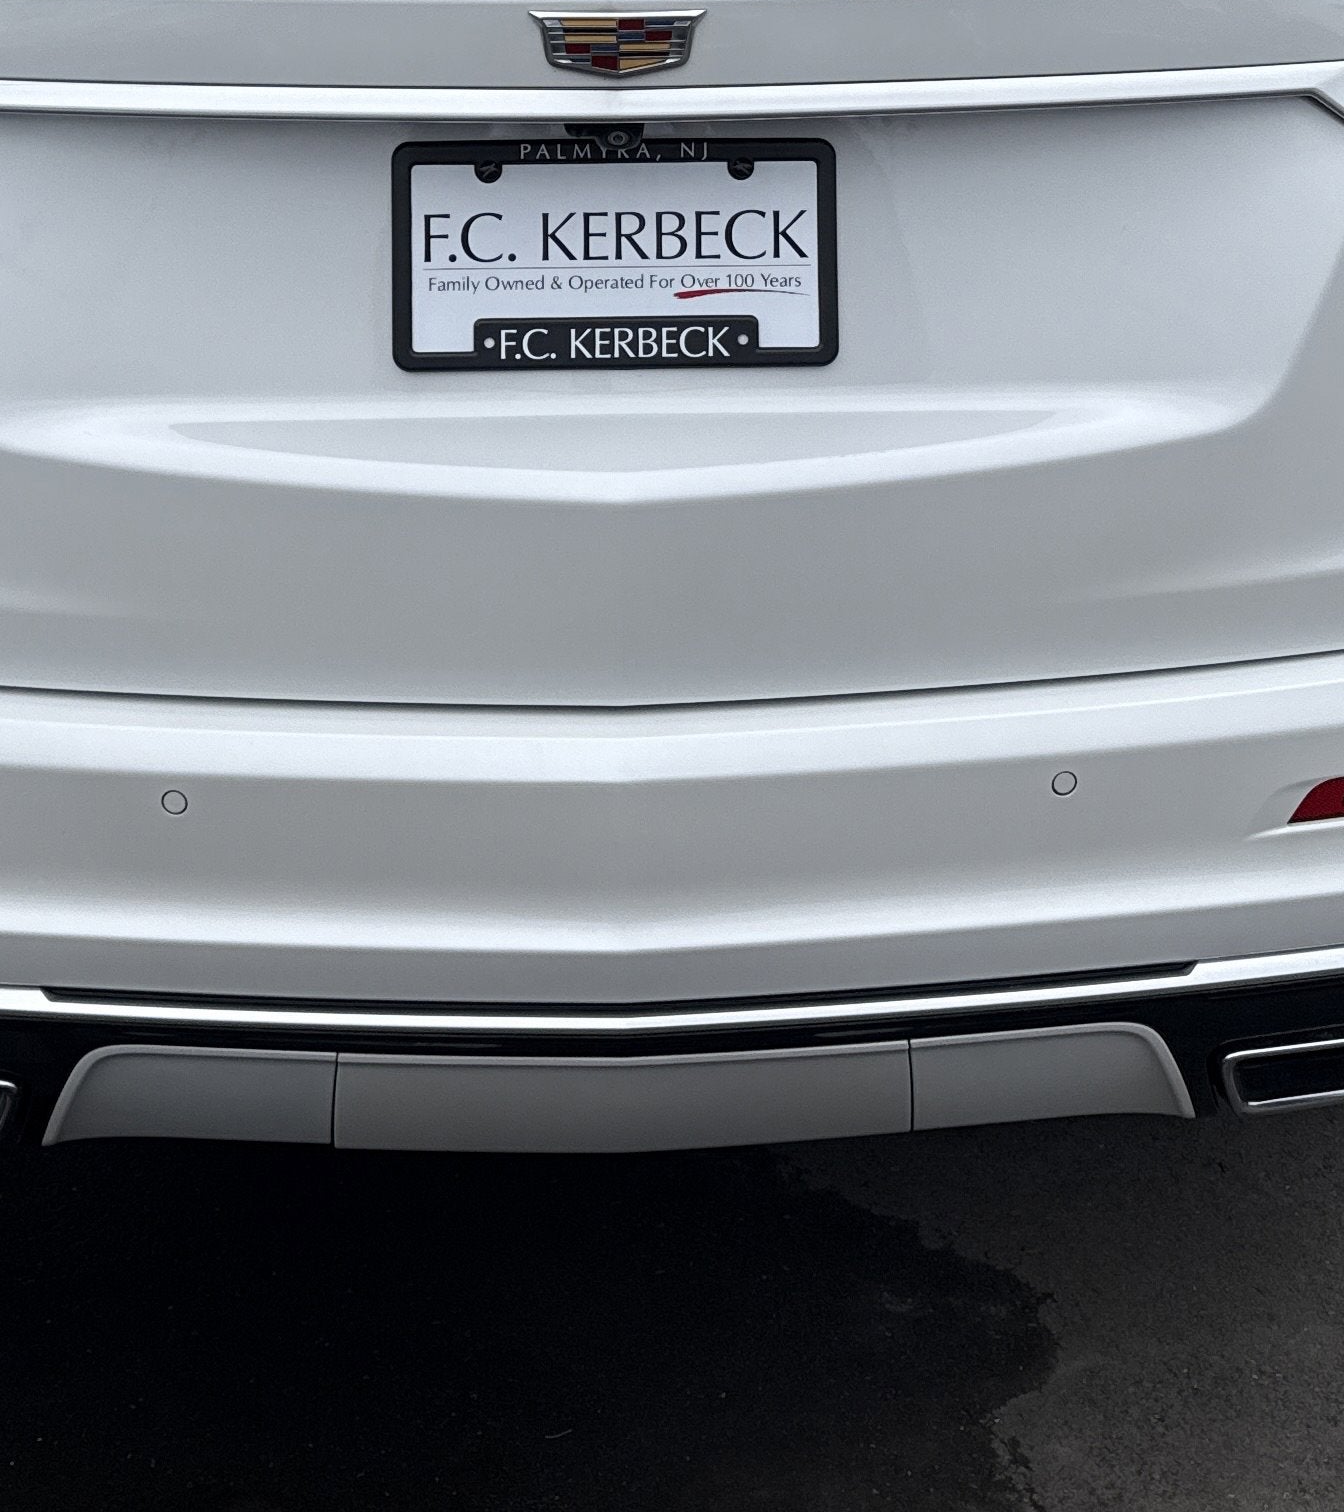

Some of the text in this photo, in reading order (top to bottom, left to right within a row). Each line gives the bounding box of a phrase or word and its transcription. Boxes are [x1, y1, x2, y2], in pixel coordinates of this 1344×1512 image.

[680, 141, 708, 161] NJ
[422, 208, 810, 264] F.C. KERBECK
[428, 272, 803, 295] Family Owned & Operated For Over 100 Years
[498, 326, 731, 361] F.C. KERBECK
